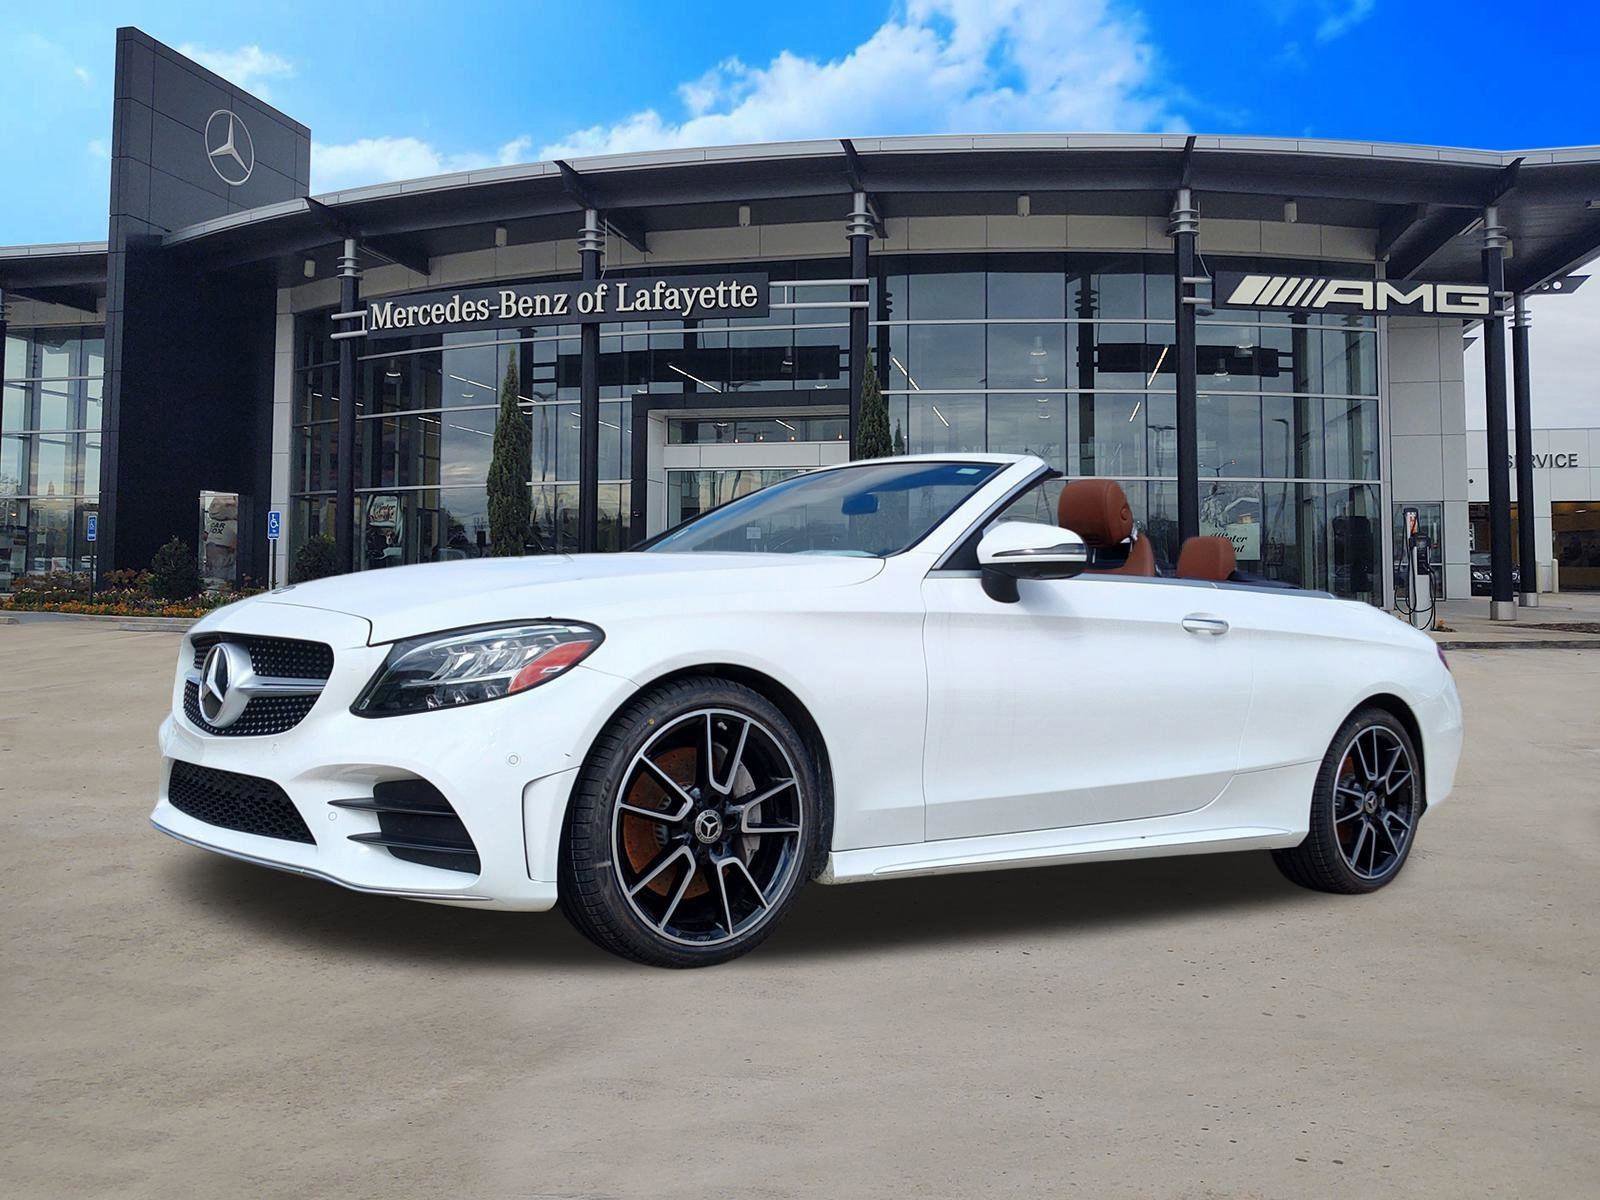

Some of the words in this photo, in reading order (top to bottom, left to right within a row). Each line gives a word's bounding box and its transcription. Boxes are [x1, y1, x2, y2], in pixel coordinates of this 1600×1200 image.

[370, 290, 568, 331] Mercedes-Benz
[577, 283, 608, 314] of
[615, 280, 758, 317] Lafayette
[1312, 279, 1489, 315] AMG
[1506, 453, 1578, 468] SRVICE
